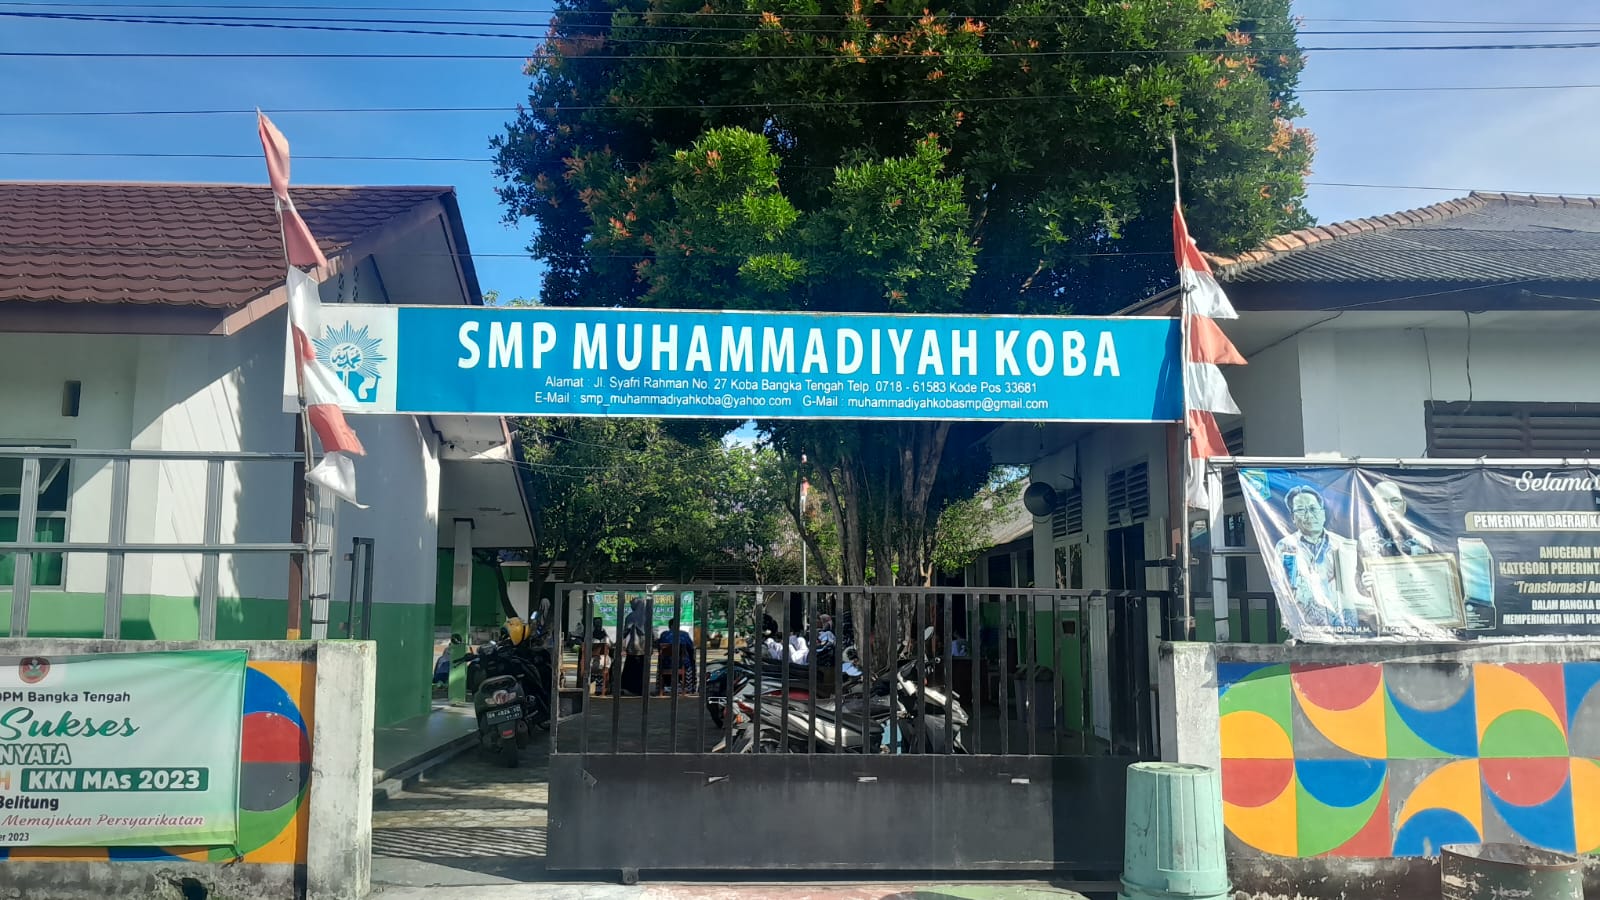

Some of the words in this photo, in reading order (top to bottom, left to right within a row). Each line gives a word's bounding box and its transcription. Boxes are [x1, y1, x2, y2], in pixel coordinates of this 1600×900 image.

[457, 320, 557, 370] SMP
[573, 322, 977, 376] MUHAMMADIYAH
[995, 328, 1121, 377] KOBA
[545, 376, 584, 388] Alamat
[609, 376, 641, 391] Syafri
[644, 377, 689, 389] Rahman
[692, 378, 709, 390] No.
[714, 378, 728, 390] 27
[731, 378, 759, 391] Koba
[762, 379, 802, 393] Bangka
[804, 379, 844, 394] Tengah
[847, 380, 871, 394] Telp.
[875, 380, 902, 392] 0718
[913, 381, 946, 393] 61583
[950, 382, 978, 393] Kode
[981, 382, 1001, 393] Pos
[1005, 382, 1037, 393] 33681
[535, 391, 570, 403] E-Mail
[580, 393, 792, 408] smp_muhammadiyahkoba@yahoo.com
[802, 395, 838, 407] G-Mail
[848, 396, 1049, 412] muhammadiyahkobasmp@gmail.com
[1473, 514, 1545, 528] PEMERINTAH
[1547, 514, 1588, 528] DAERAH
[1540, 546, 1591, 559] ANUGERAH
[1500, 562, 1549, 575] KATEGORI
[1532, 599, 1559, 610] DALAM
[1560, 599, 1595, 610] RANGKA
[1503, 614, 1562, 624] MEMPERINGATI
[1563, 614, 1585, 624] HARI
[0, 691, 23, 702] PM
[28, 691, 78, 703] Bangka
[83, 691, 131, 703] Tengah
[0, 706, 140, 741] Sukses
[28, 770, 77, 790] KKN
[82, 770, 132, 790] MAs
[138, 770, 200, 789] 2023
[1, 815, 92, 829] Memajukan
[97, 815, 204, 829] Persyarikatan
[8, 832, 30, 841] 2023
